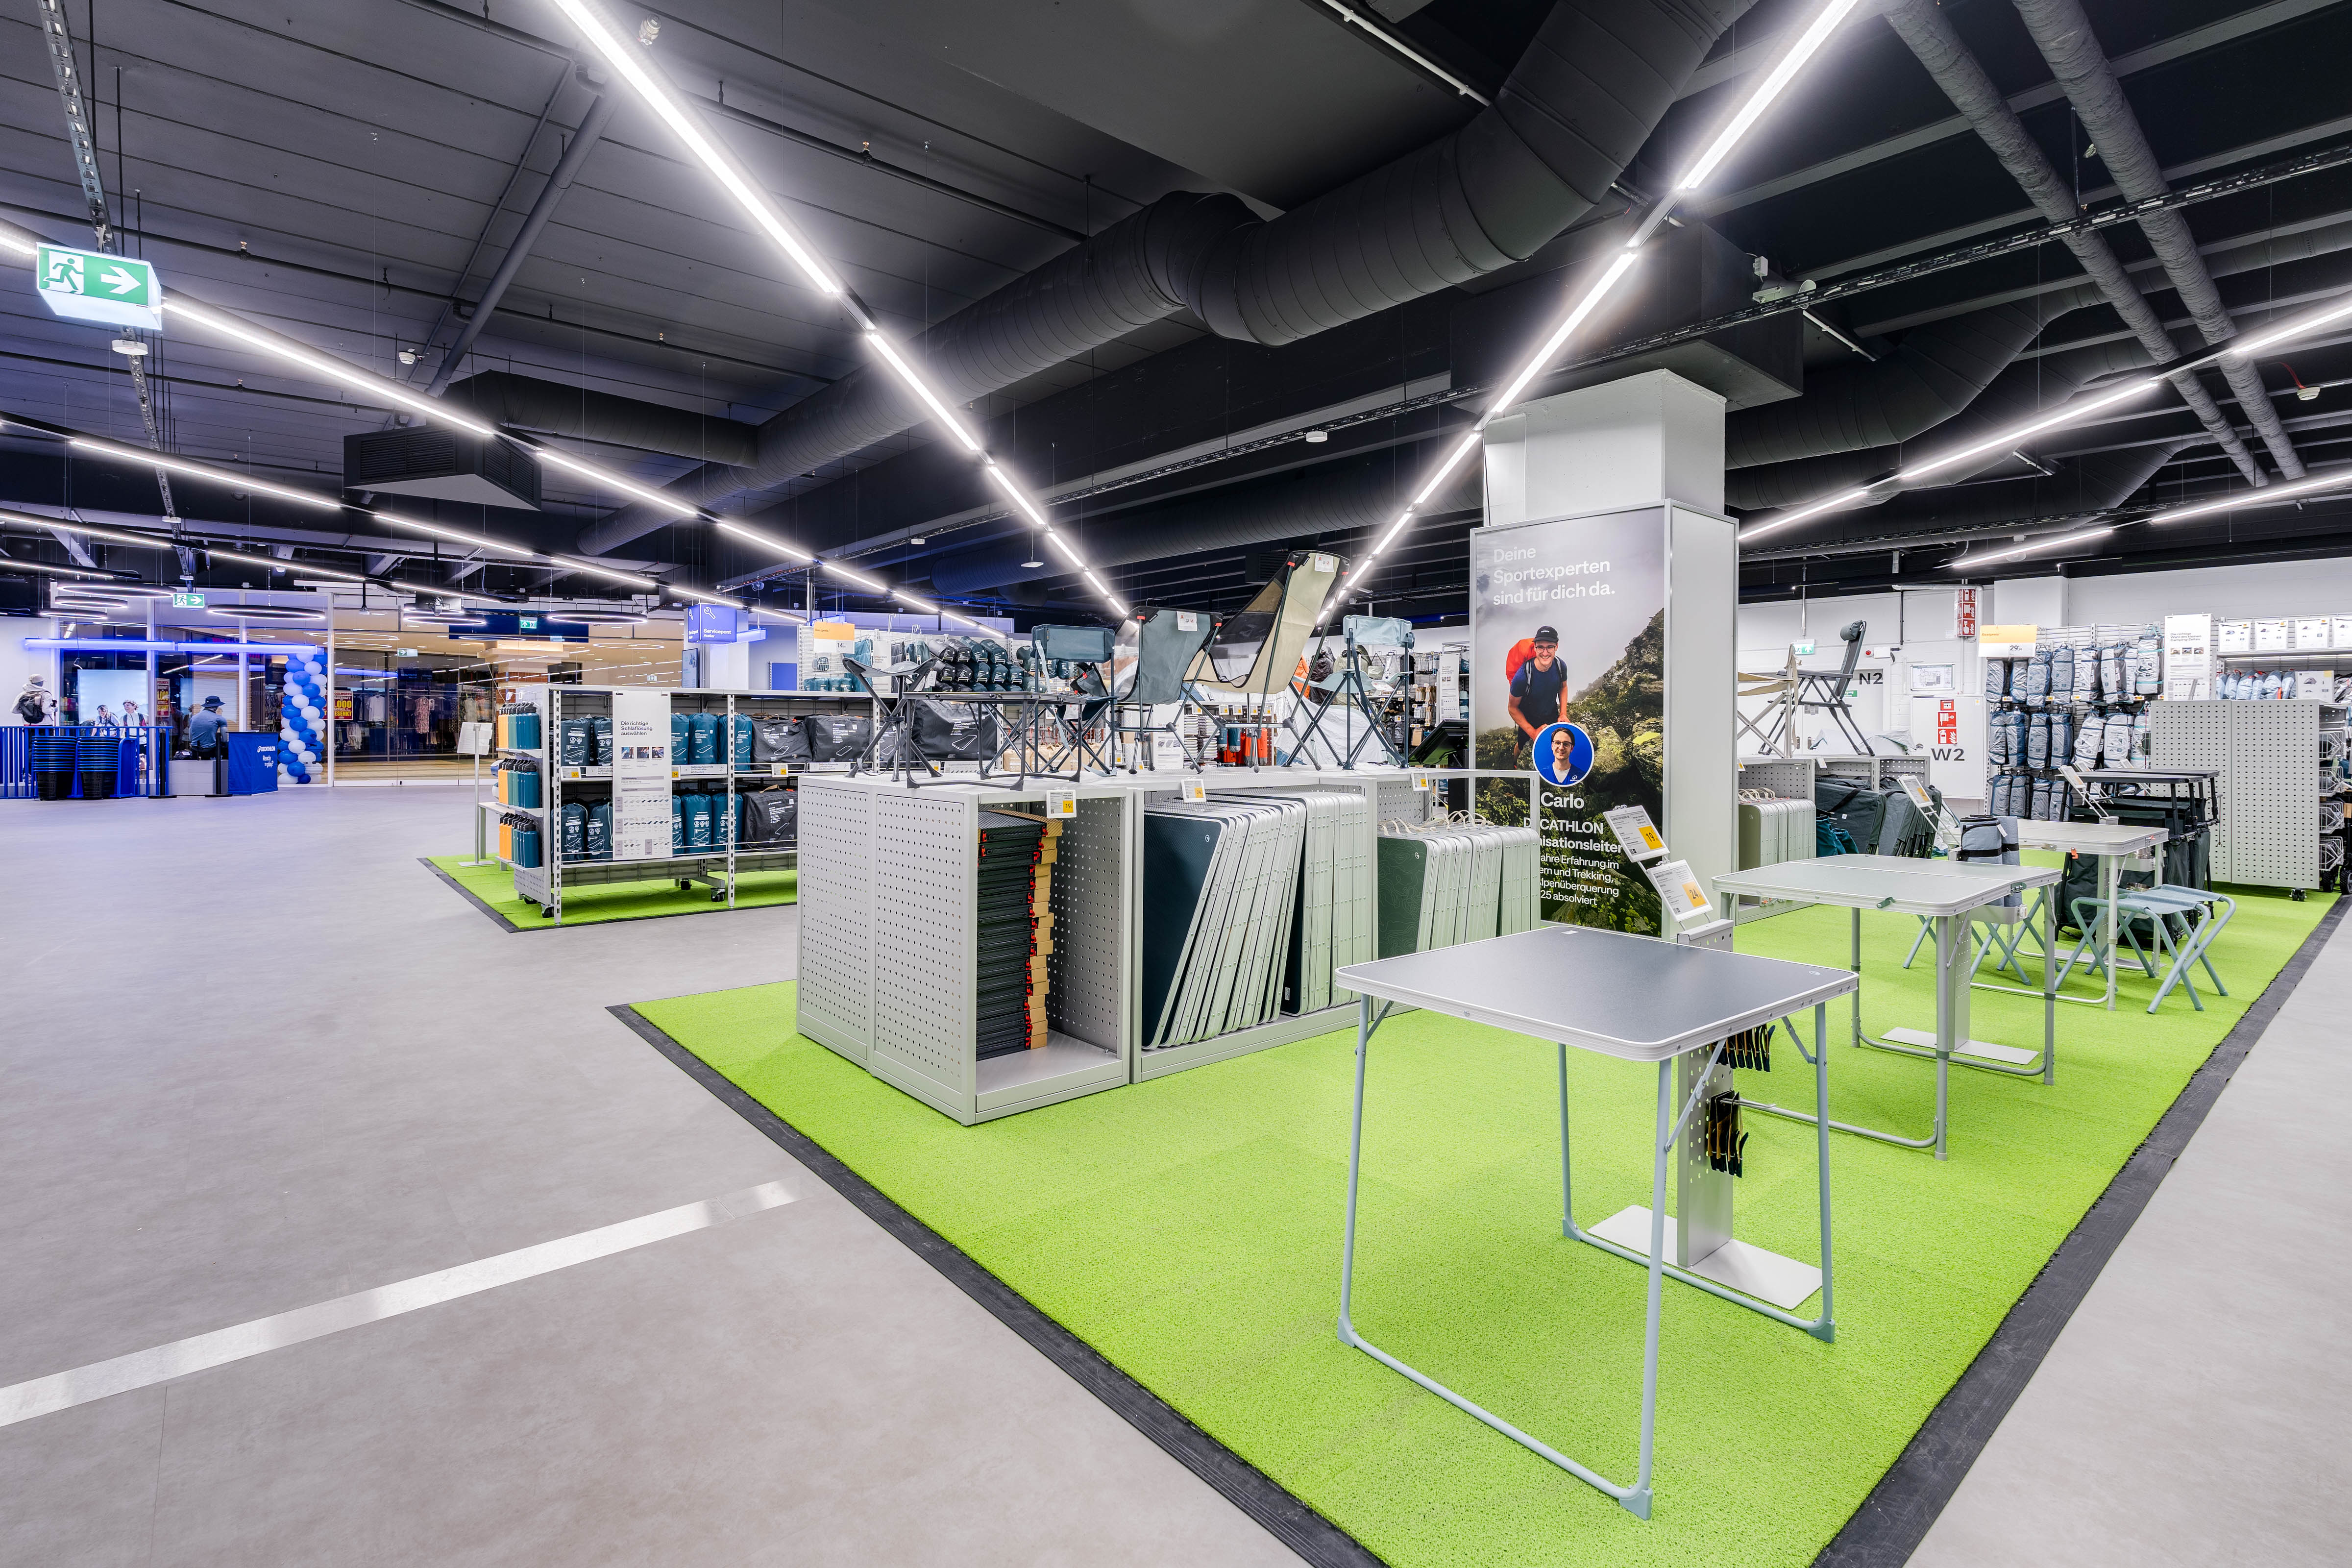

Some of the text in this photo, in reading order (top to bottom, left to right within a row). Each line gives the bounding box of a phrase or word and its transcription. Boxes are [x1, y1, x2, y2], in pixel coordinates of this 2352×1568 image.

[1494, 546, 1536, 563] Deine
[1493, 560, 1610, 587] Sportexperten
[1493, 581, 1616, 606] sind für dich da.
[1859, 672, 1883, 685] N2
[334, 700, 352, 709] .000
[1931, 748, 1965, 761] W2
[1540, 792, 1585, 809] Carlo
[1523, 817, 1604, 834] DCATHLON
[1646, 832, 1655, 842] 19
[1540, 855, 1619, 870] ahre Erfahrung im
[1553, 869, 1571, 877] und
[1571, 868, 1614, 884] Trekking,
[1540, 889, 1597, 906] 25 absolviert
[1689, 888, 1699, 900] 24
